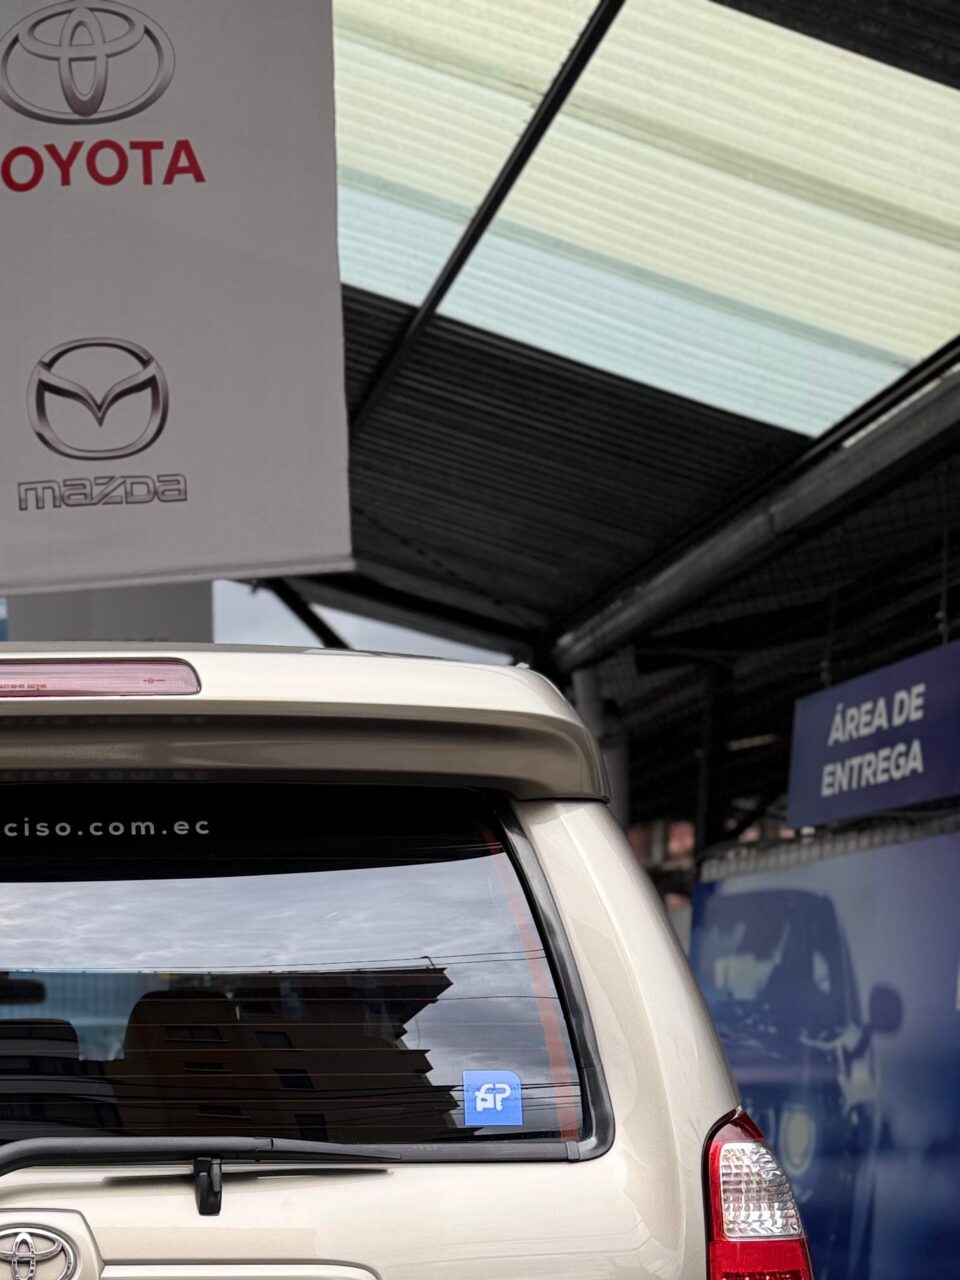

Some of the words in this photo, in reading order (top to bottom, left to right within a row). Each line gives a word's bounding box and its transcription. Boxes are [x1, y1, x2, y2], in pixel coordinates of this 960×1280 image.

[18, 473, 188, 511] mazda
[827, 697, 889, 747] ÁREA
[891, 683, 927, 728] DE
[820, 739, 925, 798] ENTREGA
